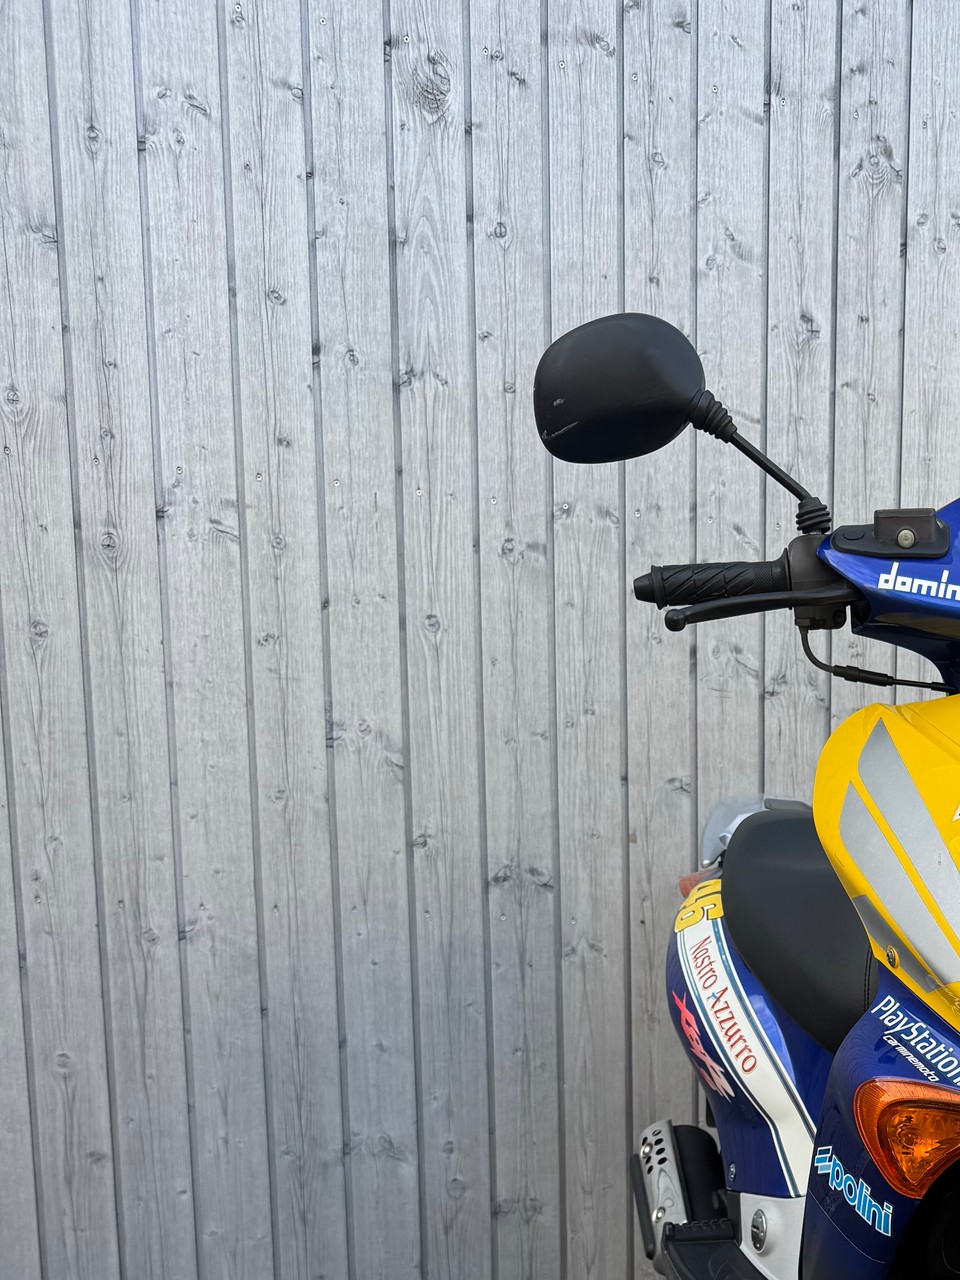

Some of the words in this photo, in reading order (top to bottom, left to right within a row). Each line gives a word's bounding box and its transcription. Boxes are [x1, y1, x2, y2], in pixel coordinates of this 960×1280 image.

[690, 935, 718, 991] Nastro
[706, 986, 758, 1075] Azzurro
[882, 1034, 940, 1083] carminemoto
[827, 1151, 894, 1238] polini
